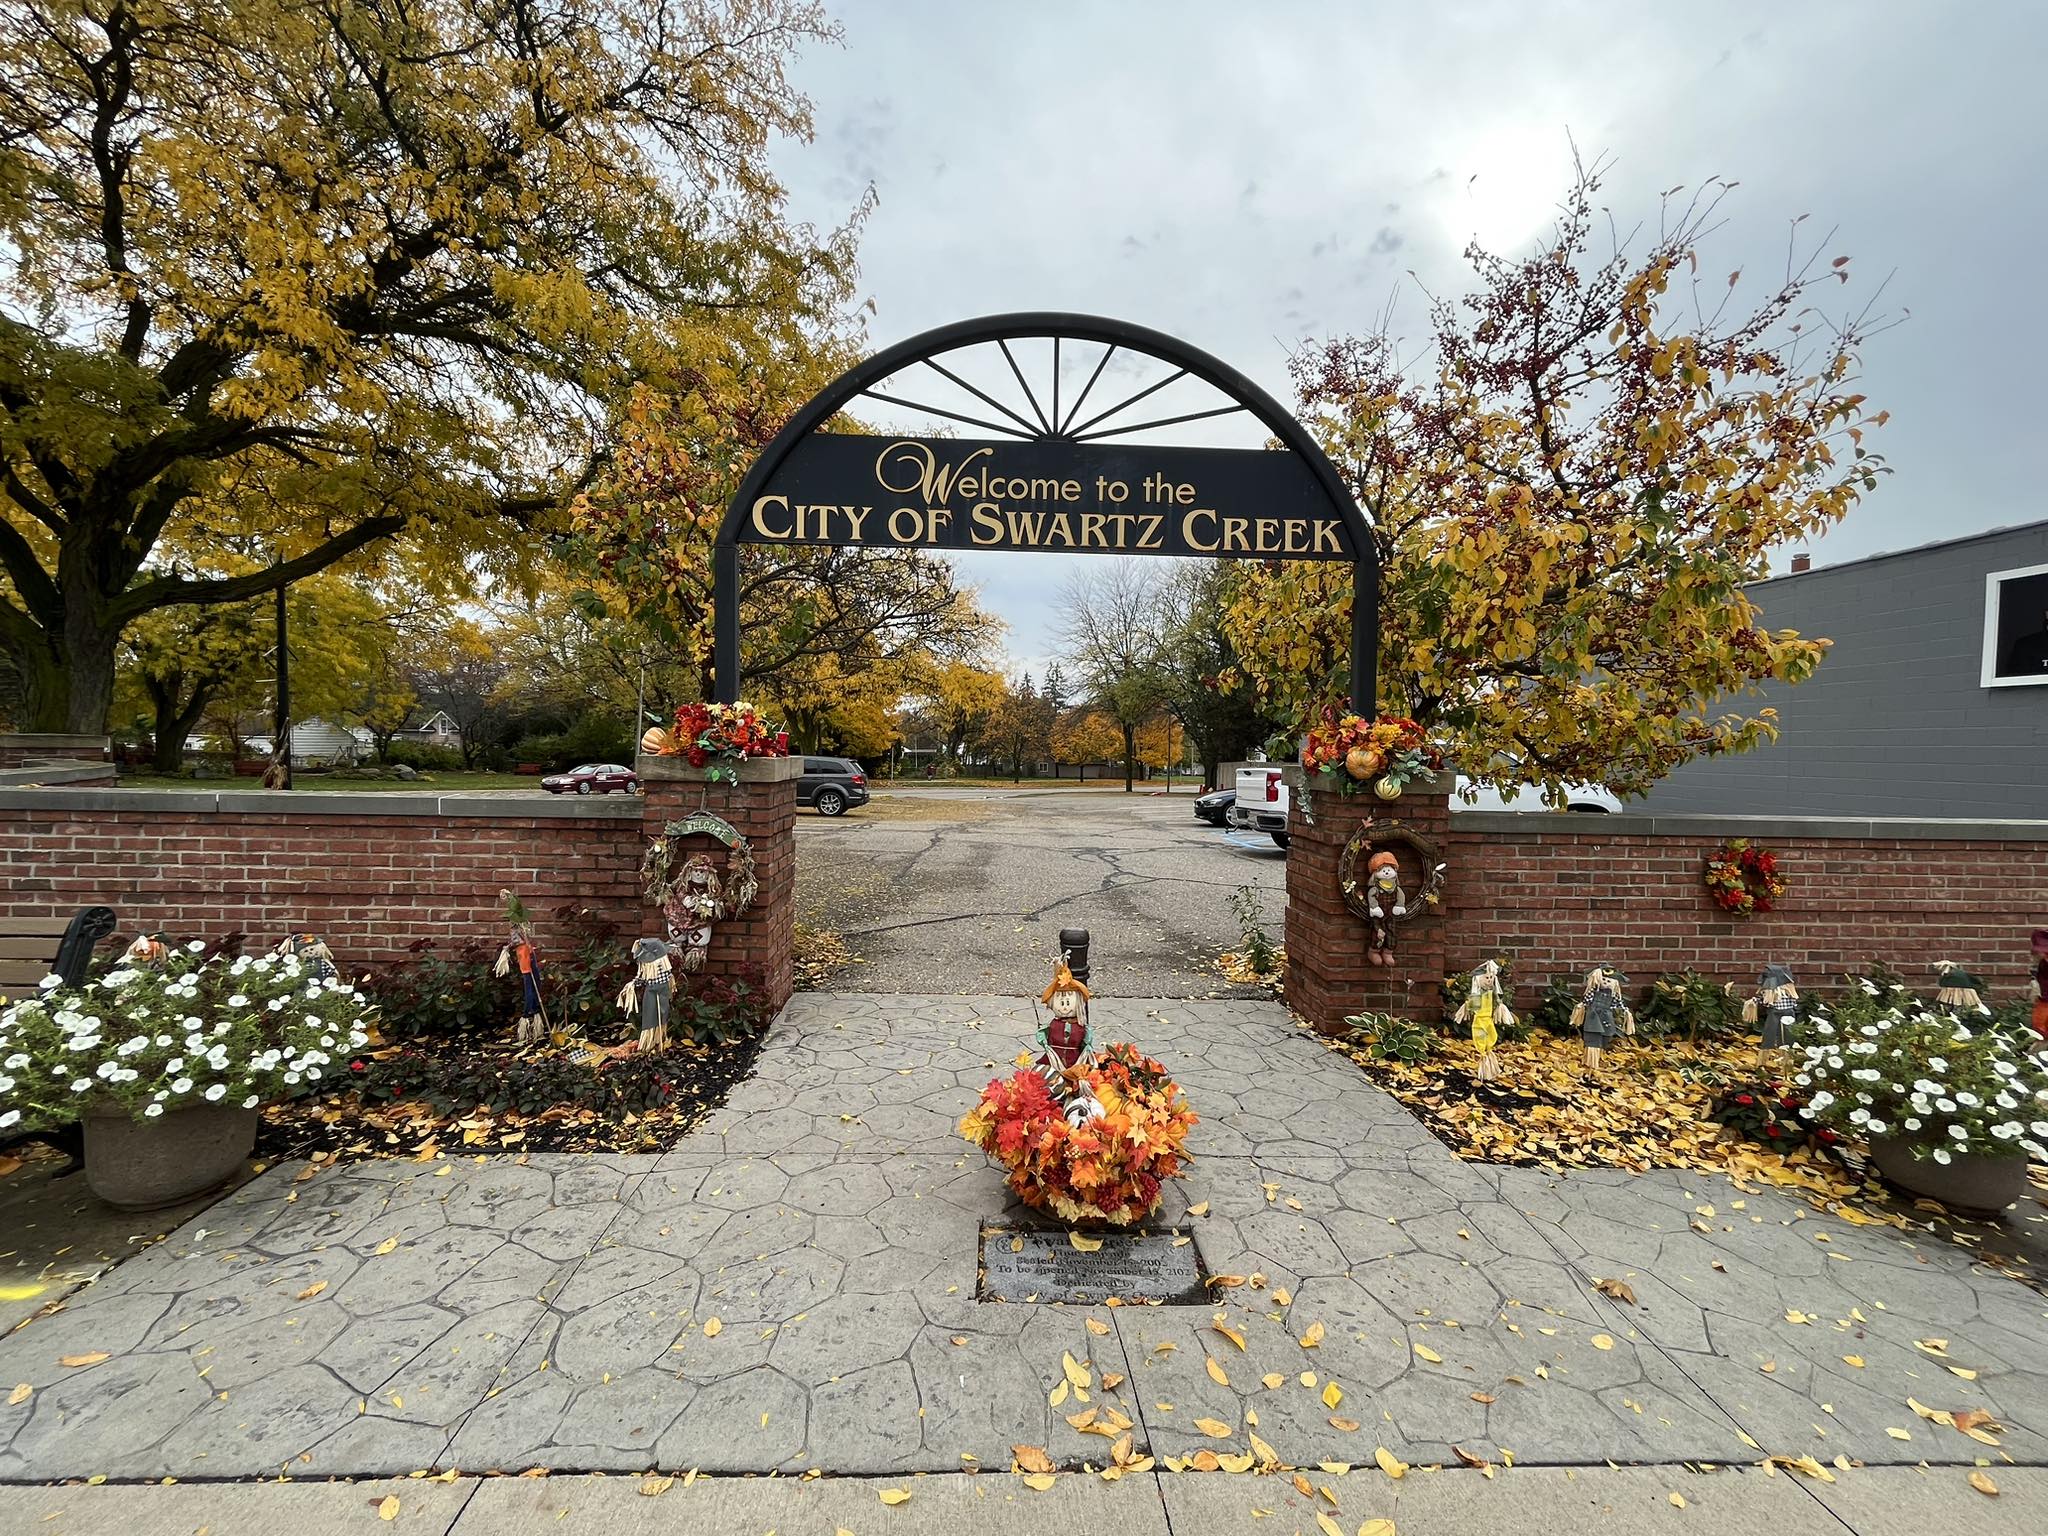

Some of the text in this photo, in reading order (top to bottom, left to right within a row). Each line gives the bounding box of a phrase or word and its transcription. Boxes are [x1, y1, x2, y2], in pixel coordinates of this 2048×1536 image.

[875, 441, 1197, 505] Welcome to the
[752, 495, 1344, 553] CITY OF SWARTZ CREEK
[687, 821, 730, 840] WELCOME
[1017, 1257, 1055, 1265] Sealed
[1059, 1257, 1119, 1267] November
[996, 1264, 1012, 1274] To
[1016, 1265, 1031, 1274] be
[1084, 1266, 1145, 1276] November
[1166, 1269, 1190, 1277] 2102
[1055, 1278, 1136, 1290] Dedicated by
[1054, 1289, 1069, 1299] of
